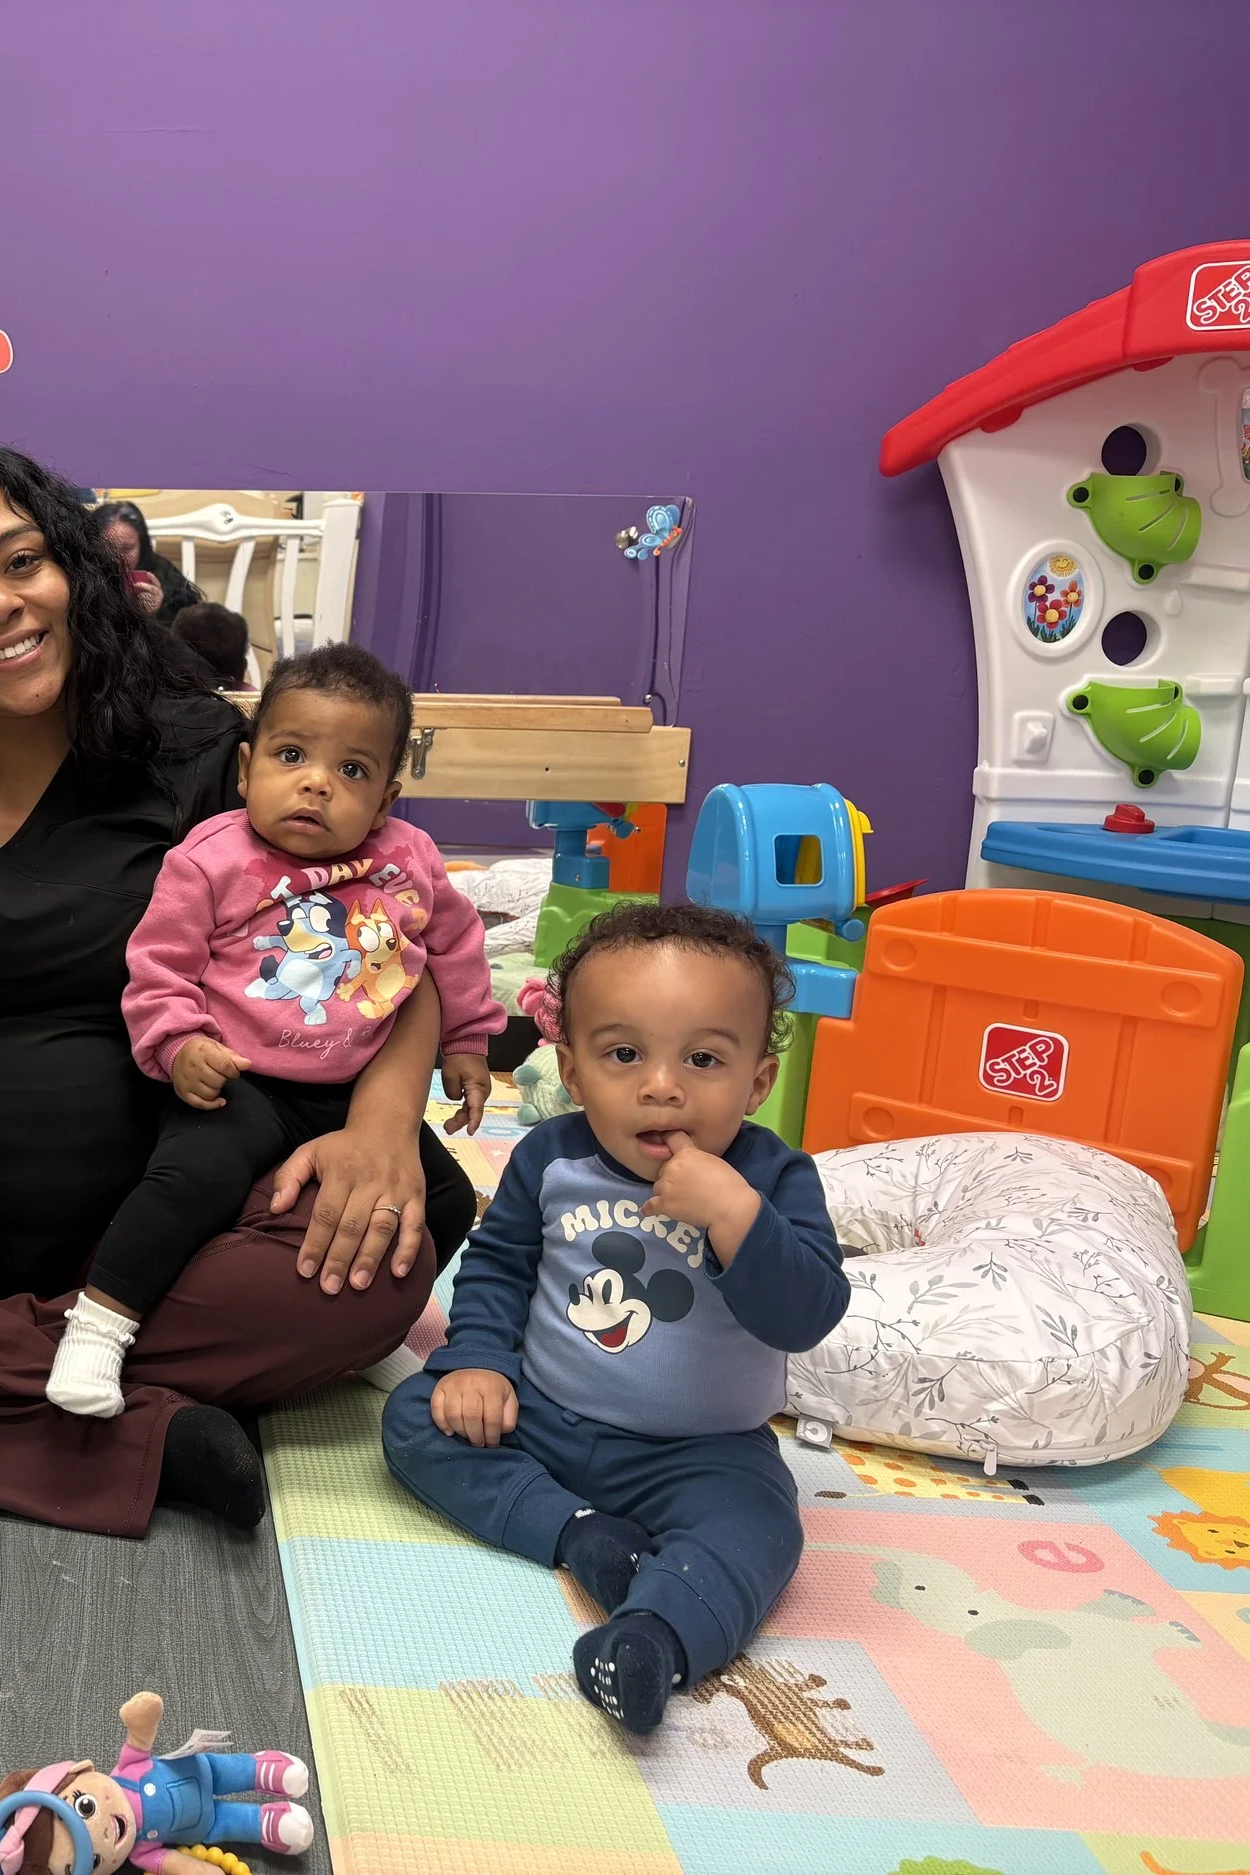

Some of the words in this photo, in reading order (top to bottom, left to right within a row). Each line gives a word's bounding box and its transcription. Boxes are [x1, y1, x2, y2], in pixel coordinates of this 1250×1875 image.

[278, 1029, 341, 1060] Bluey
[986, 1037, 1054, 1087] STEP
[1026, 1067, 1057, 1095] 2
